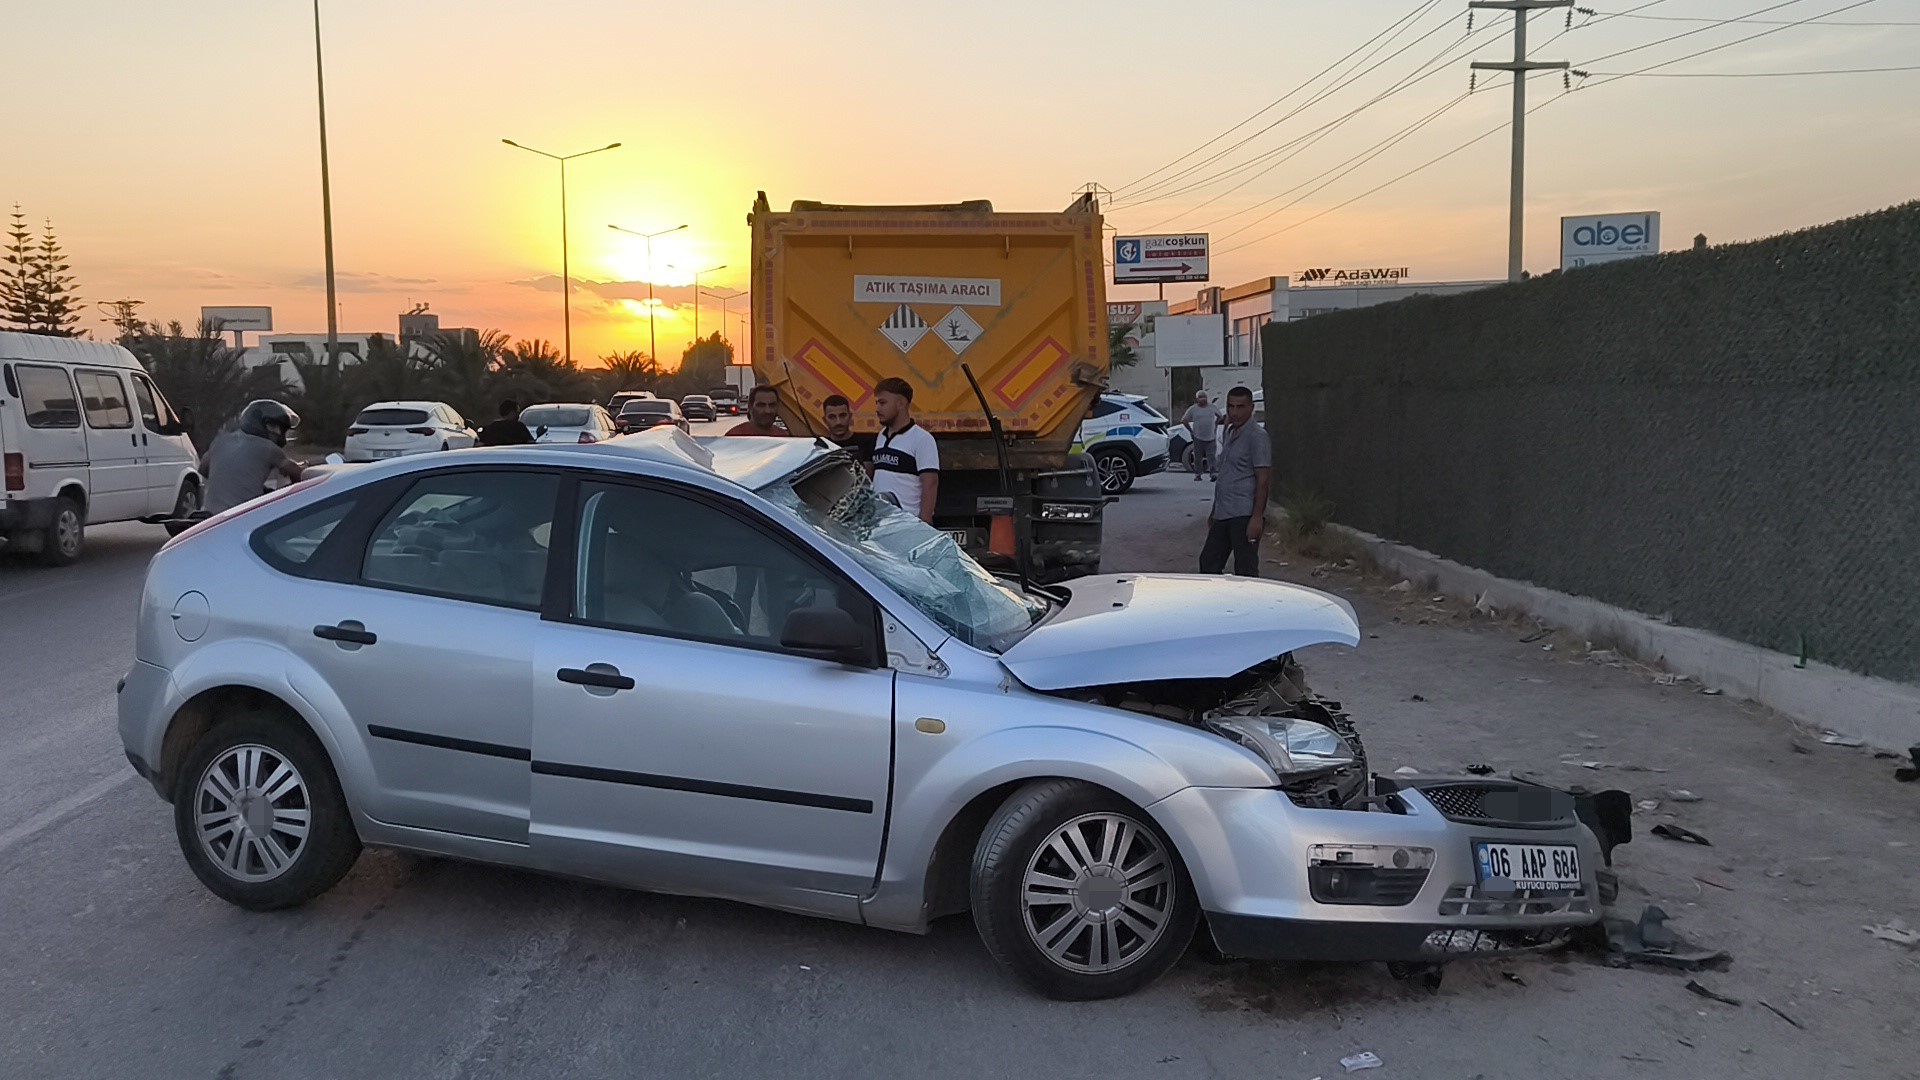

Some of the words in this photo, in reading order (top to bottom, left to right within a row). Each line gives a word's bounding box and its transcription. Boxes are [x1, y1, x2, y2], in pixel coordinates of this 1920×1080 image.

[1573, 214, 1650, 246] abel
[1145, 236, 1205, 249] gazicoşkun
[1334, 267, 1408, 281] AdaWall
[866, 281, 895, 294] ATIK
[900, 282, 948, 296] TAŞIMA
[951, 284, 990, 296] ARACI
[953, 531, 965, 544] 07
[1490, 847, 1511, 877] 06
[1521, 848, 1547, 878] AAP
[1553, 849, 1578, 879] 684
[1516, 881, 1545, 889] KUYUCU
[1546, 882, 1559, 890] OTO
